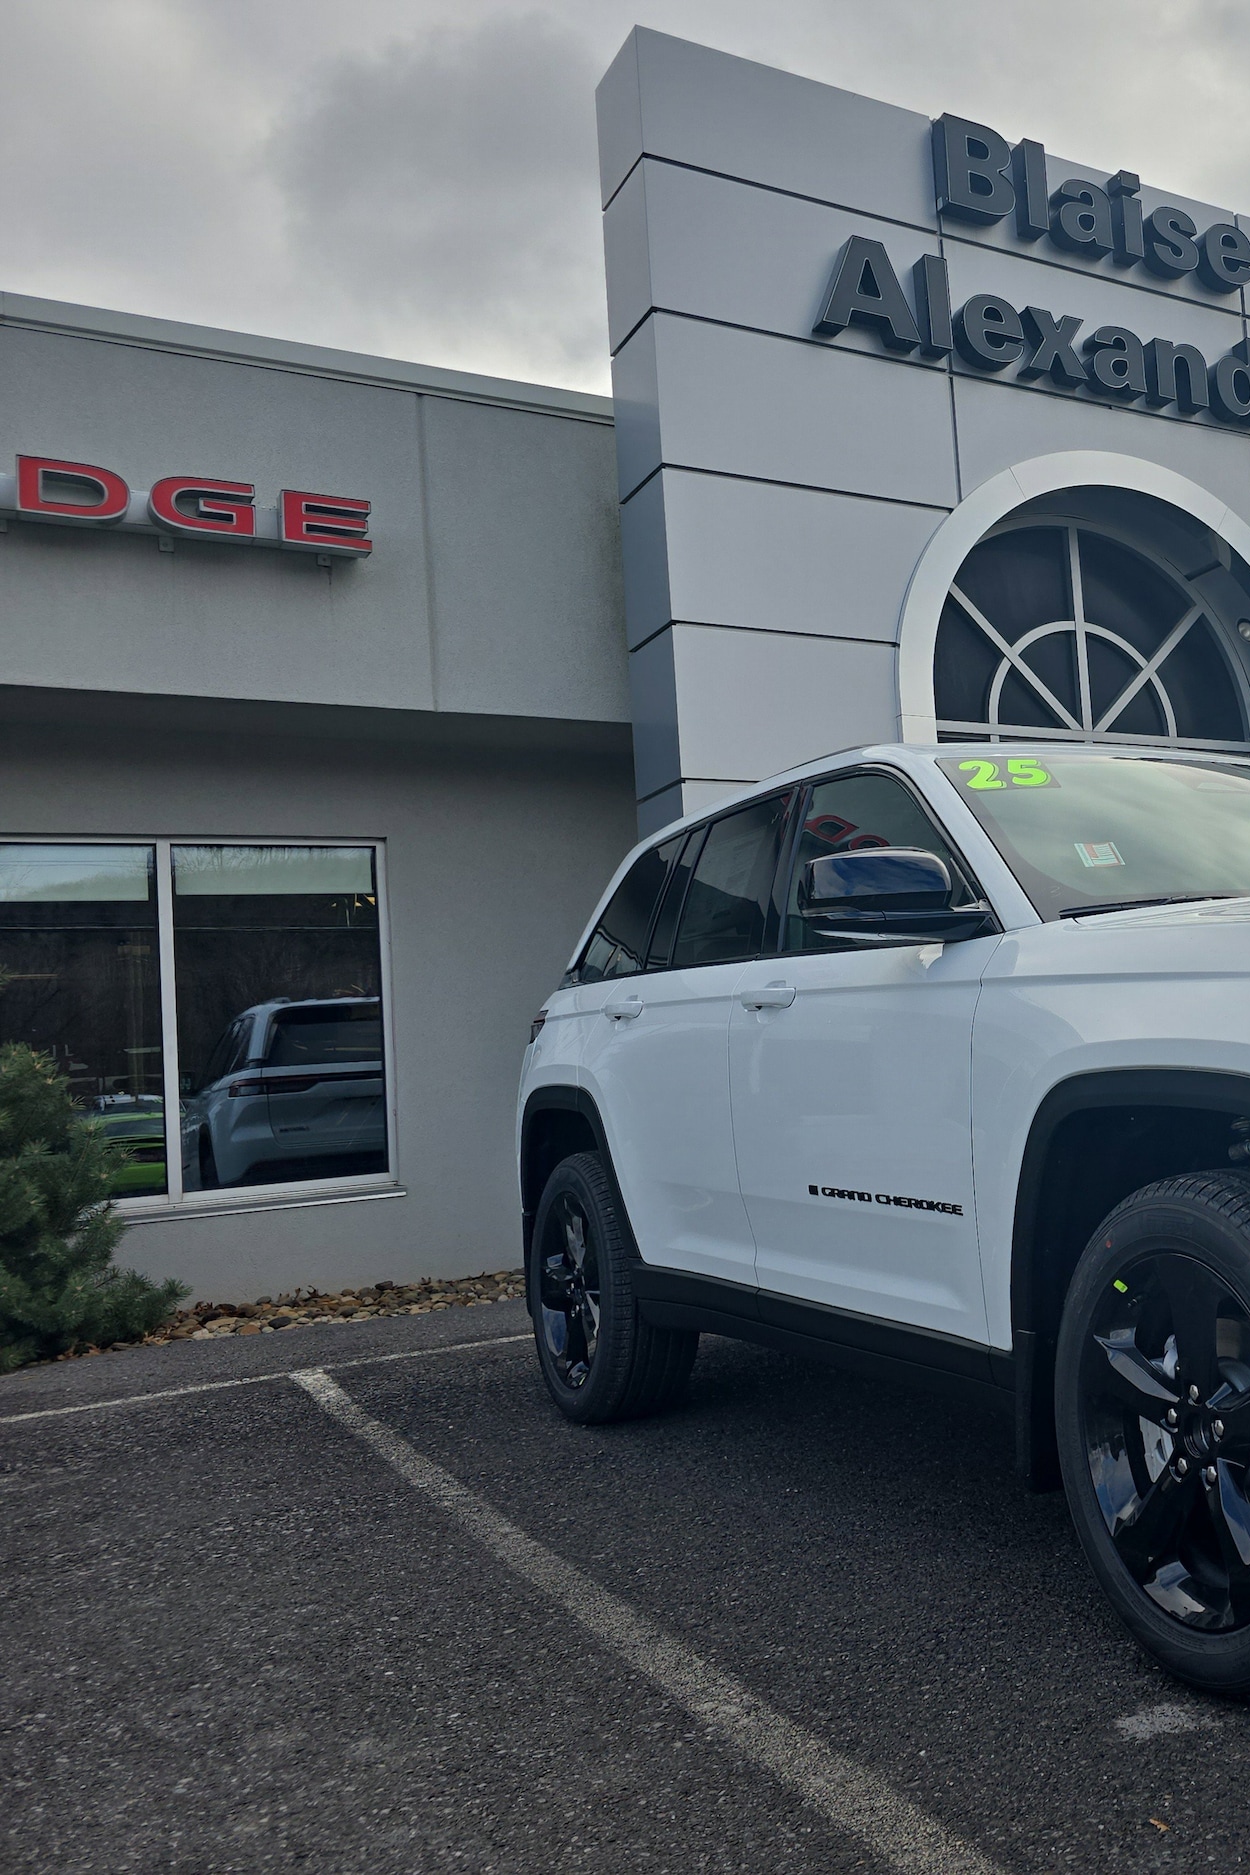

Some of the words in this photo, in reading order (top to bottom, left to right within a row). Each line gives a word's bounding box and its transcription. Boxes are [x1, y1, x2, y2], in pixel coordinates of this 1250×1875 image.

[15, 453, 373, 559] DGE
[958, 759, 1052, 790] 25
[821, 1186, 872, 1203] GRAND
[875, 1194, 964, 1217] CHEROKEE
